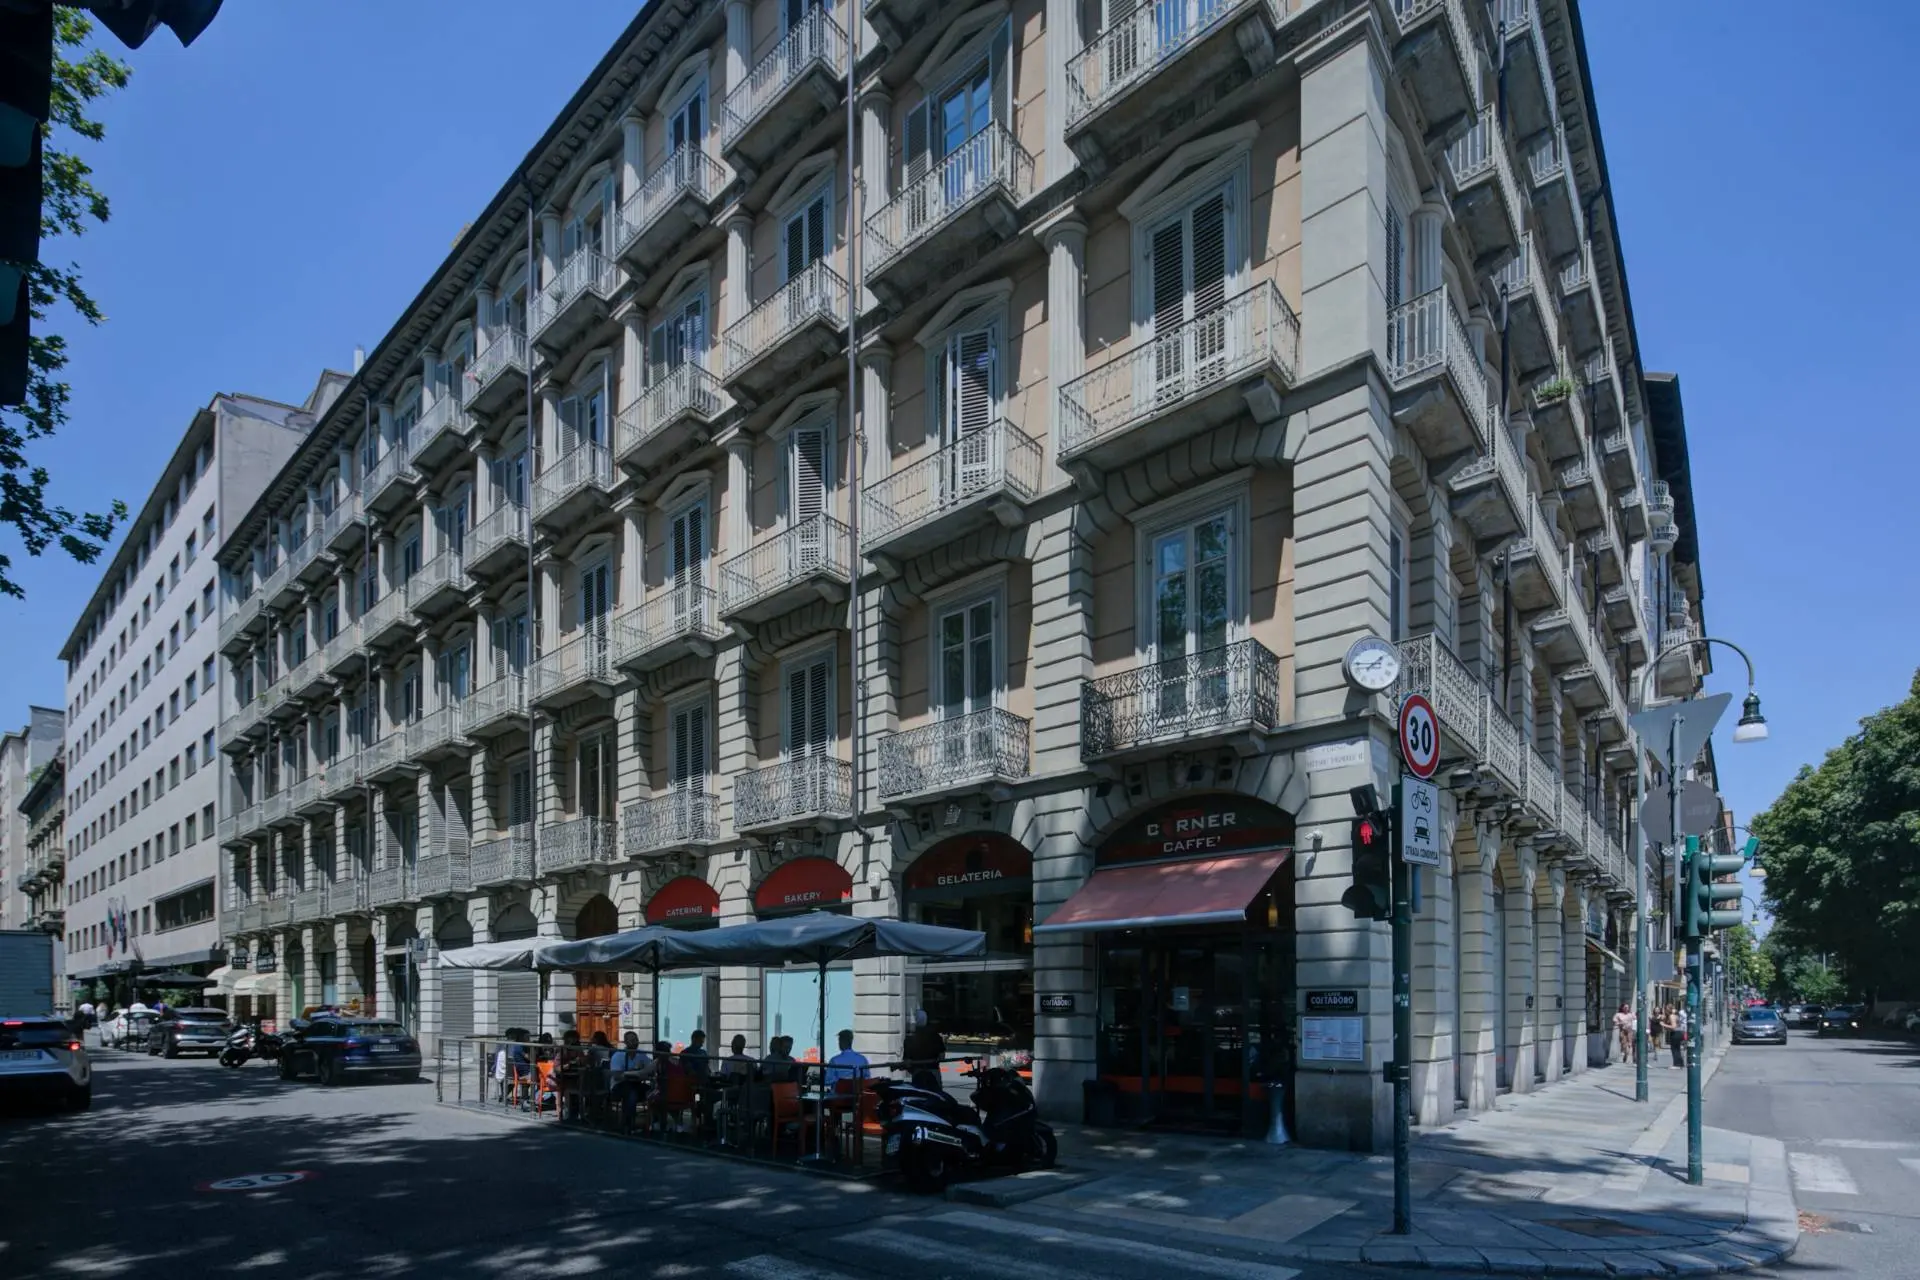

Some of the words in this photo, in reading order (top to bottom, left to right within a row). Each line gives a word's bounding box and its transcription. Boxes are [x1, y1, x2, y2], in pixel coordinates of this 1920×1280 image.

[1410, 716, 1431, 755] 30
[1147, 812, 1236, 836] CRNER
[937, 870, 1002, 885] GELATERIA
[784, 891, 822, 903] BAKERY
[666, 906, 702, 917] CATERING
